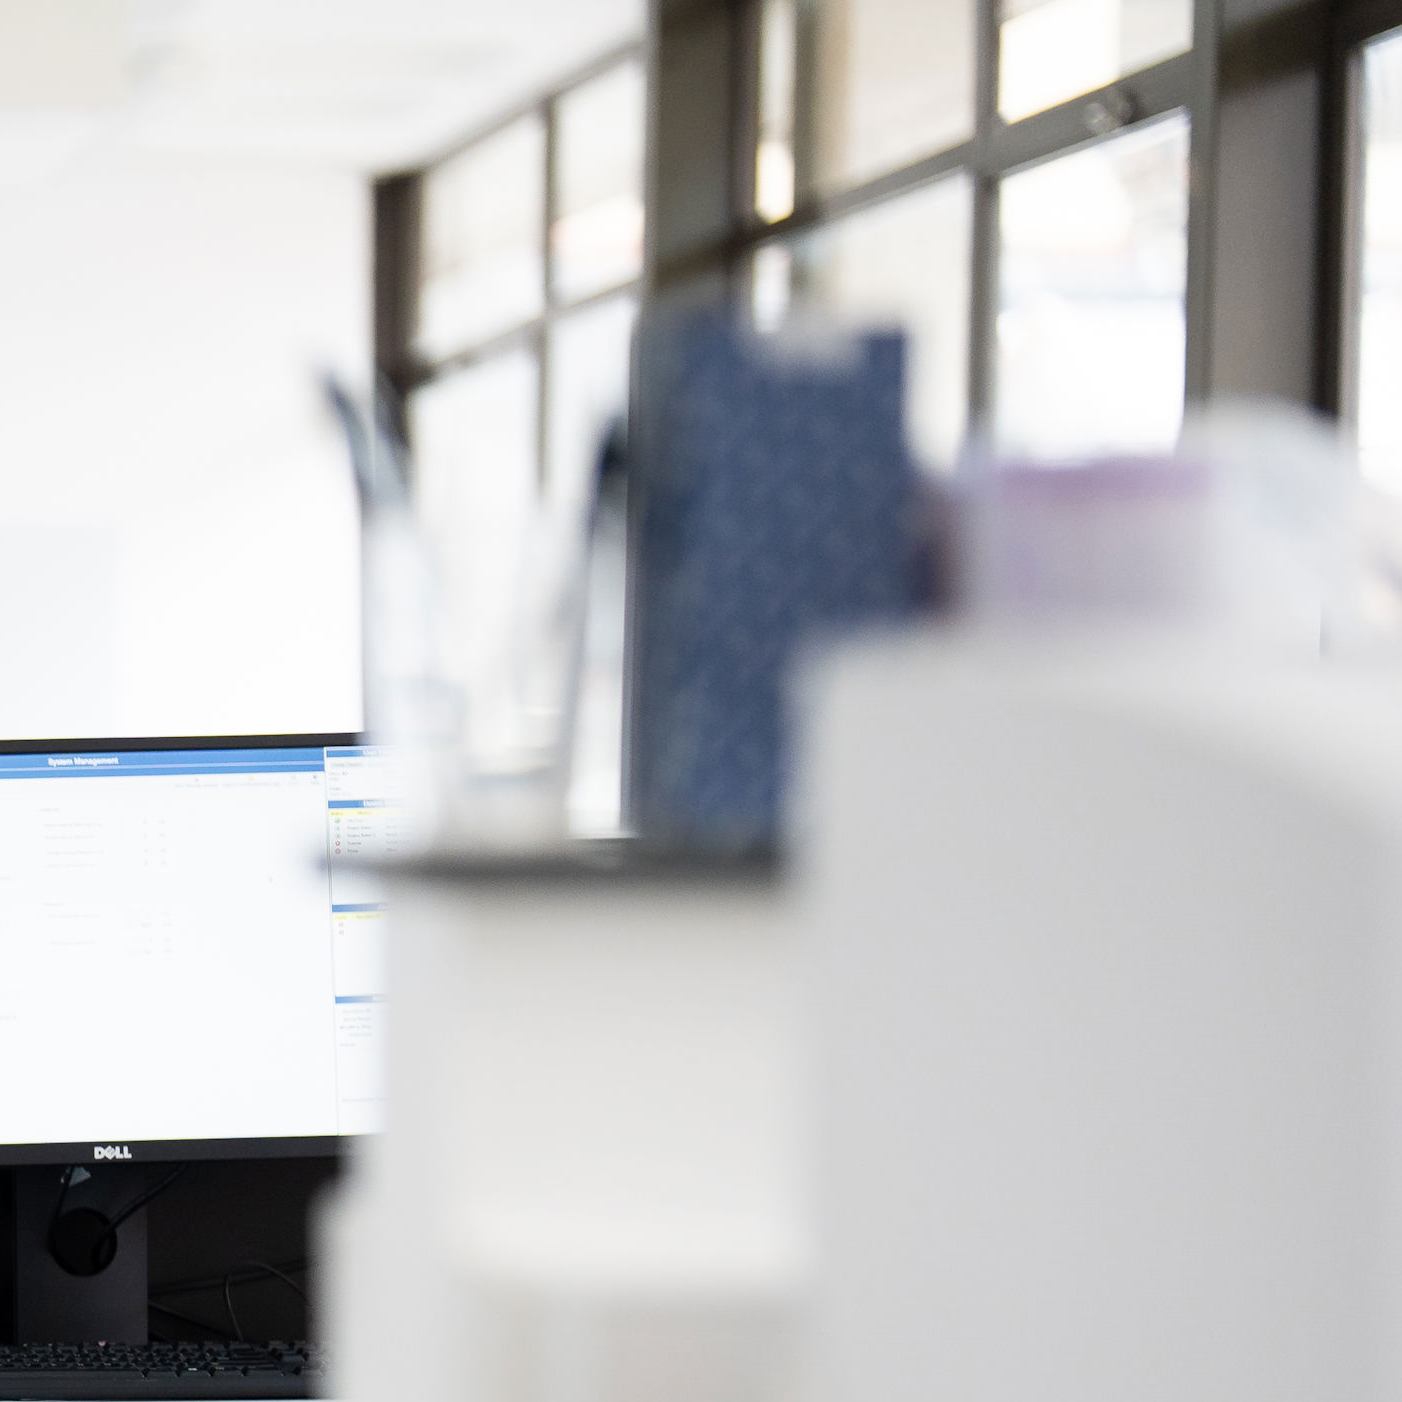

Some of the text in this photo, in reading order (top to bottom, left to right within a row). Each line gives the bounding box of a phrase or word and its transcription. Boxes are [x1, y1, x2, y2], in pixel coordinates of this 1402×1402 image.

[47, 757, 119, 767] System Management
[93, 1145, 132, 1160] DELL
